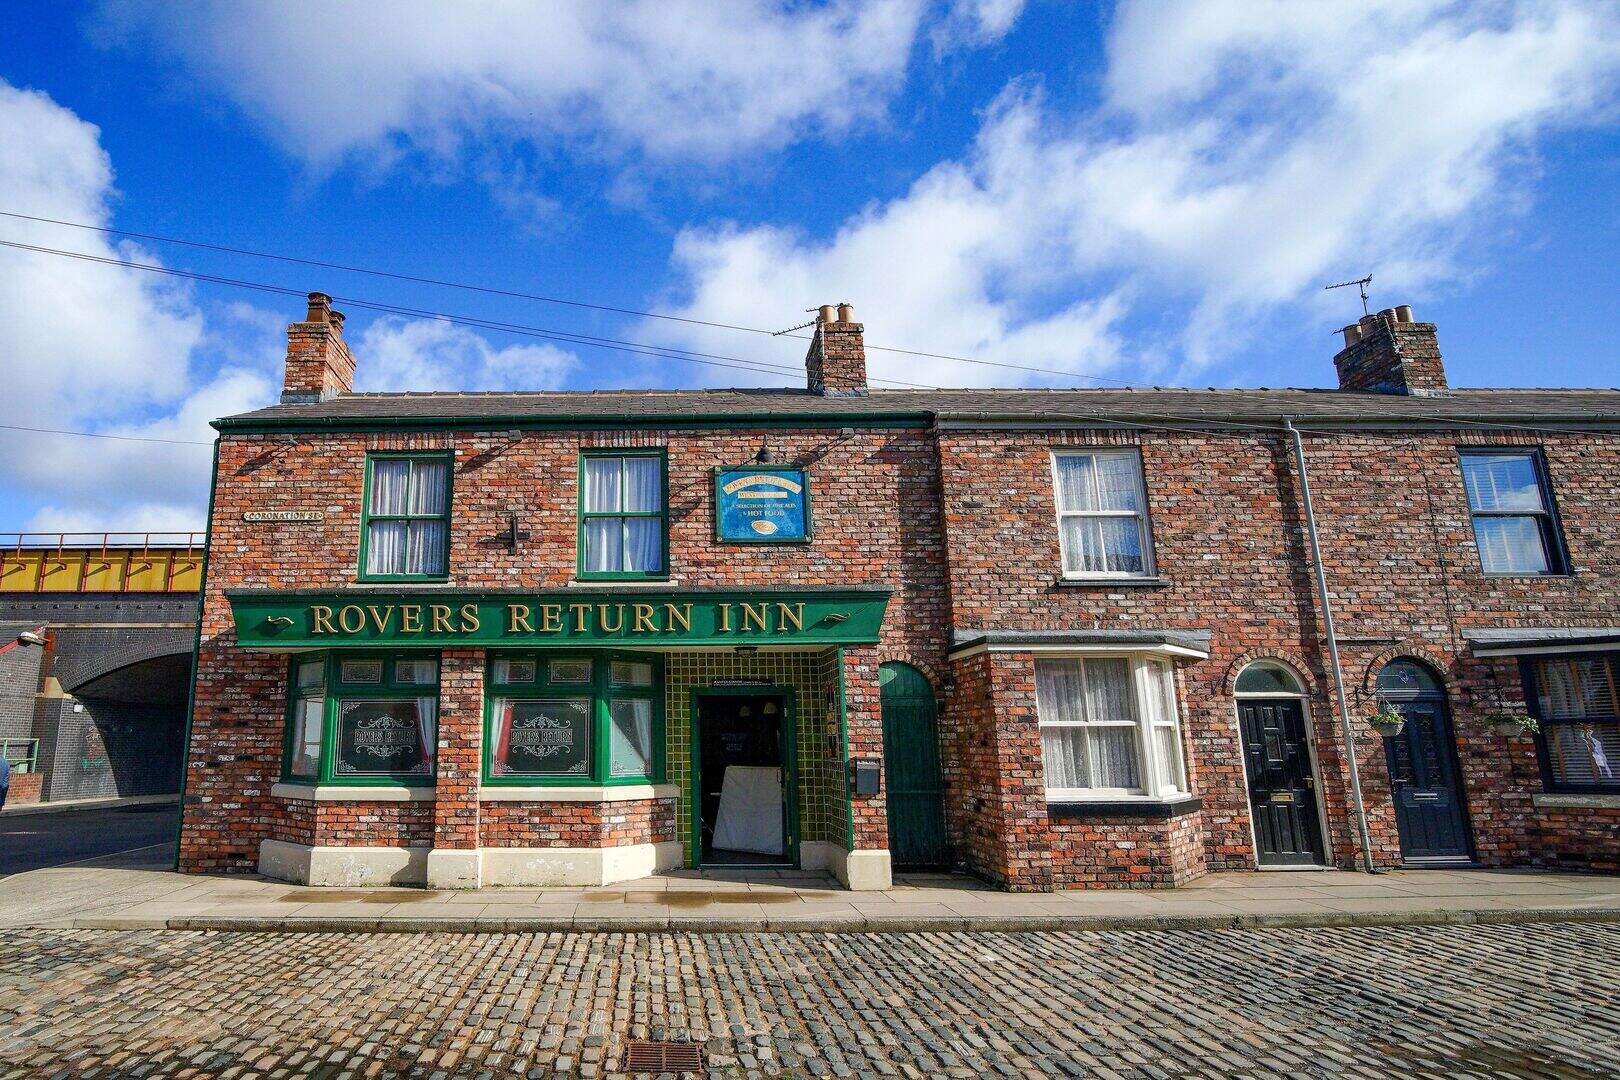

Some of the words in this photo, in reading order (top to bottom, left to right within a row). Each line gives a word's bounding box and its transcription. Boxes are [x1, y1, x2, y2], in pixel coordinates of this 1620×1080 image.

[249, 512, 305, 520] CORONATION
[310, 603, 481, 634] ROVERS
[507, 603, 694, 633] RETURN
[718, 602, 806, 632] INN
[355, 730, 383, 743] ROVERS
[511, 730, 540, 743] ROVERS
[541, 730, 573, 743] RETURN
